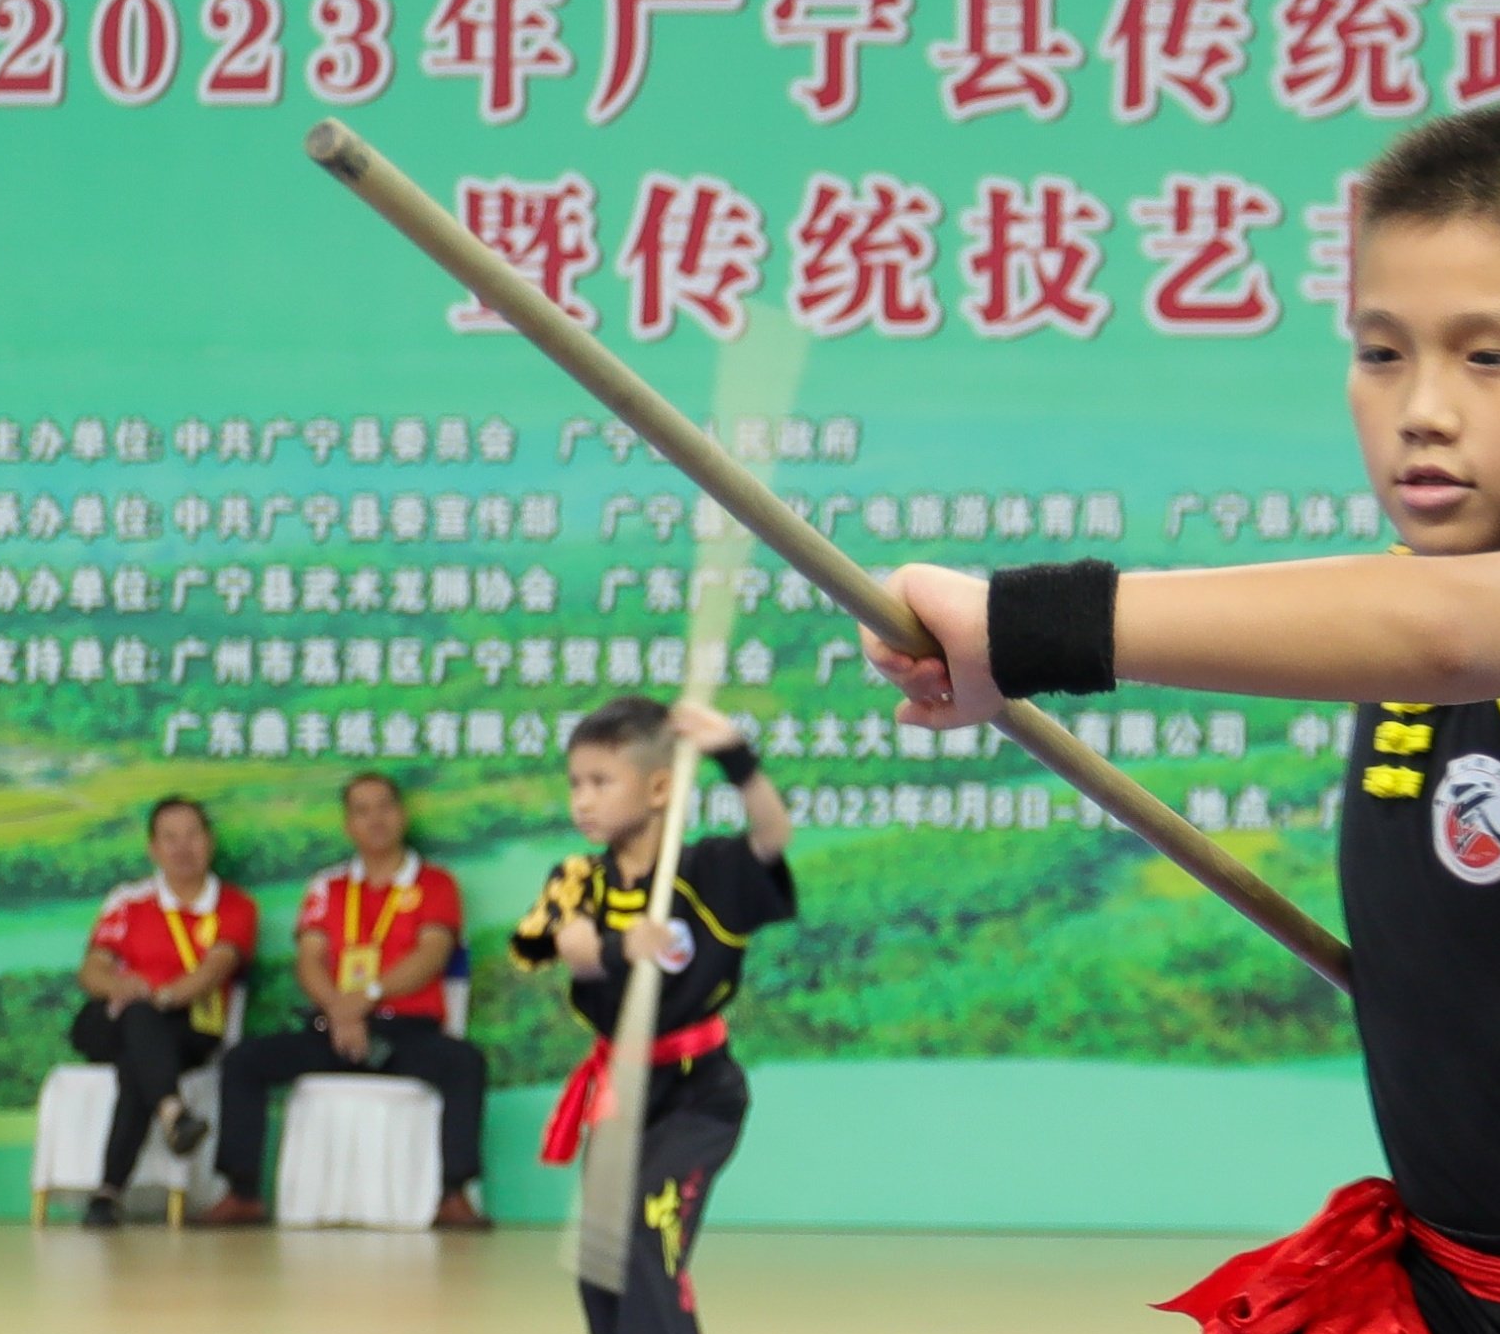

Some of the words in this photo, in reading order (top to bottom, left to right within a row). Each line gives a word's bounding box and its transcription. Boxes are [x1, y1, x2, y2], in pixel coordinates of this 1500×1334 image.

[560, 416, 858, 464] 广宁民政府
